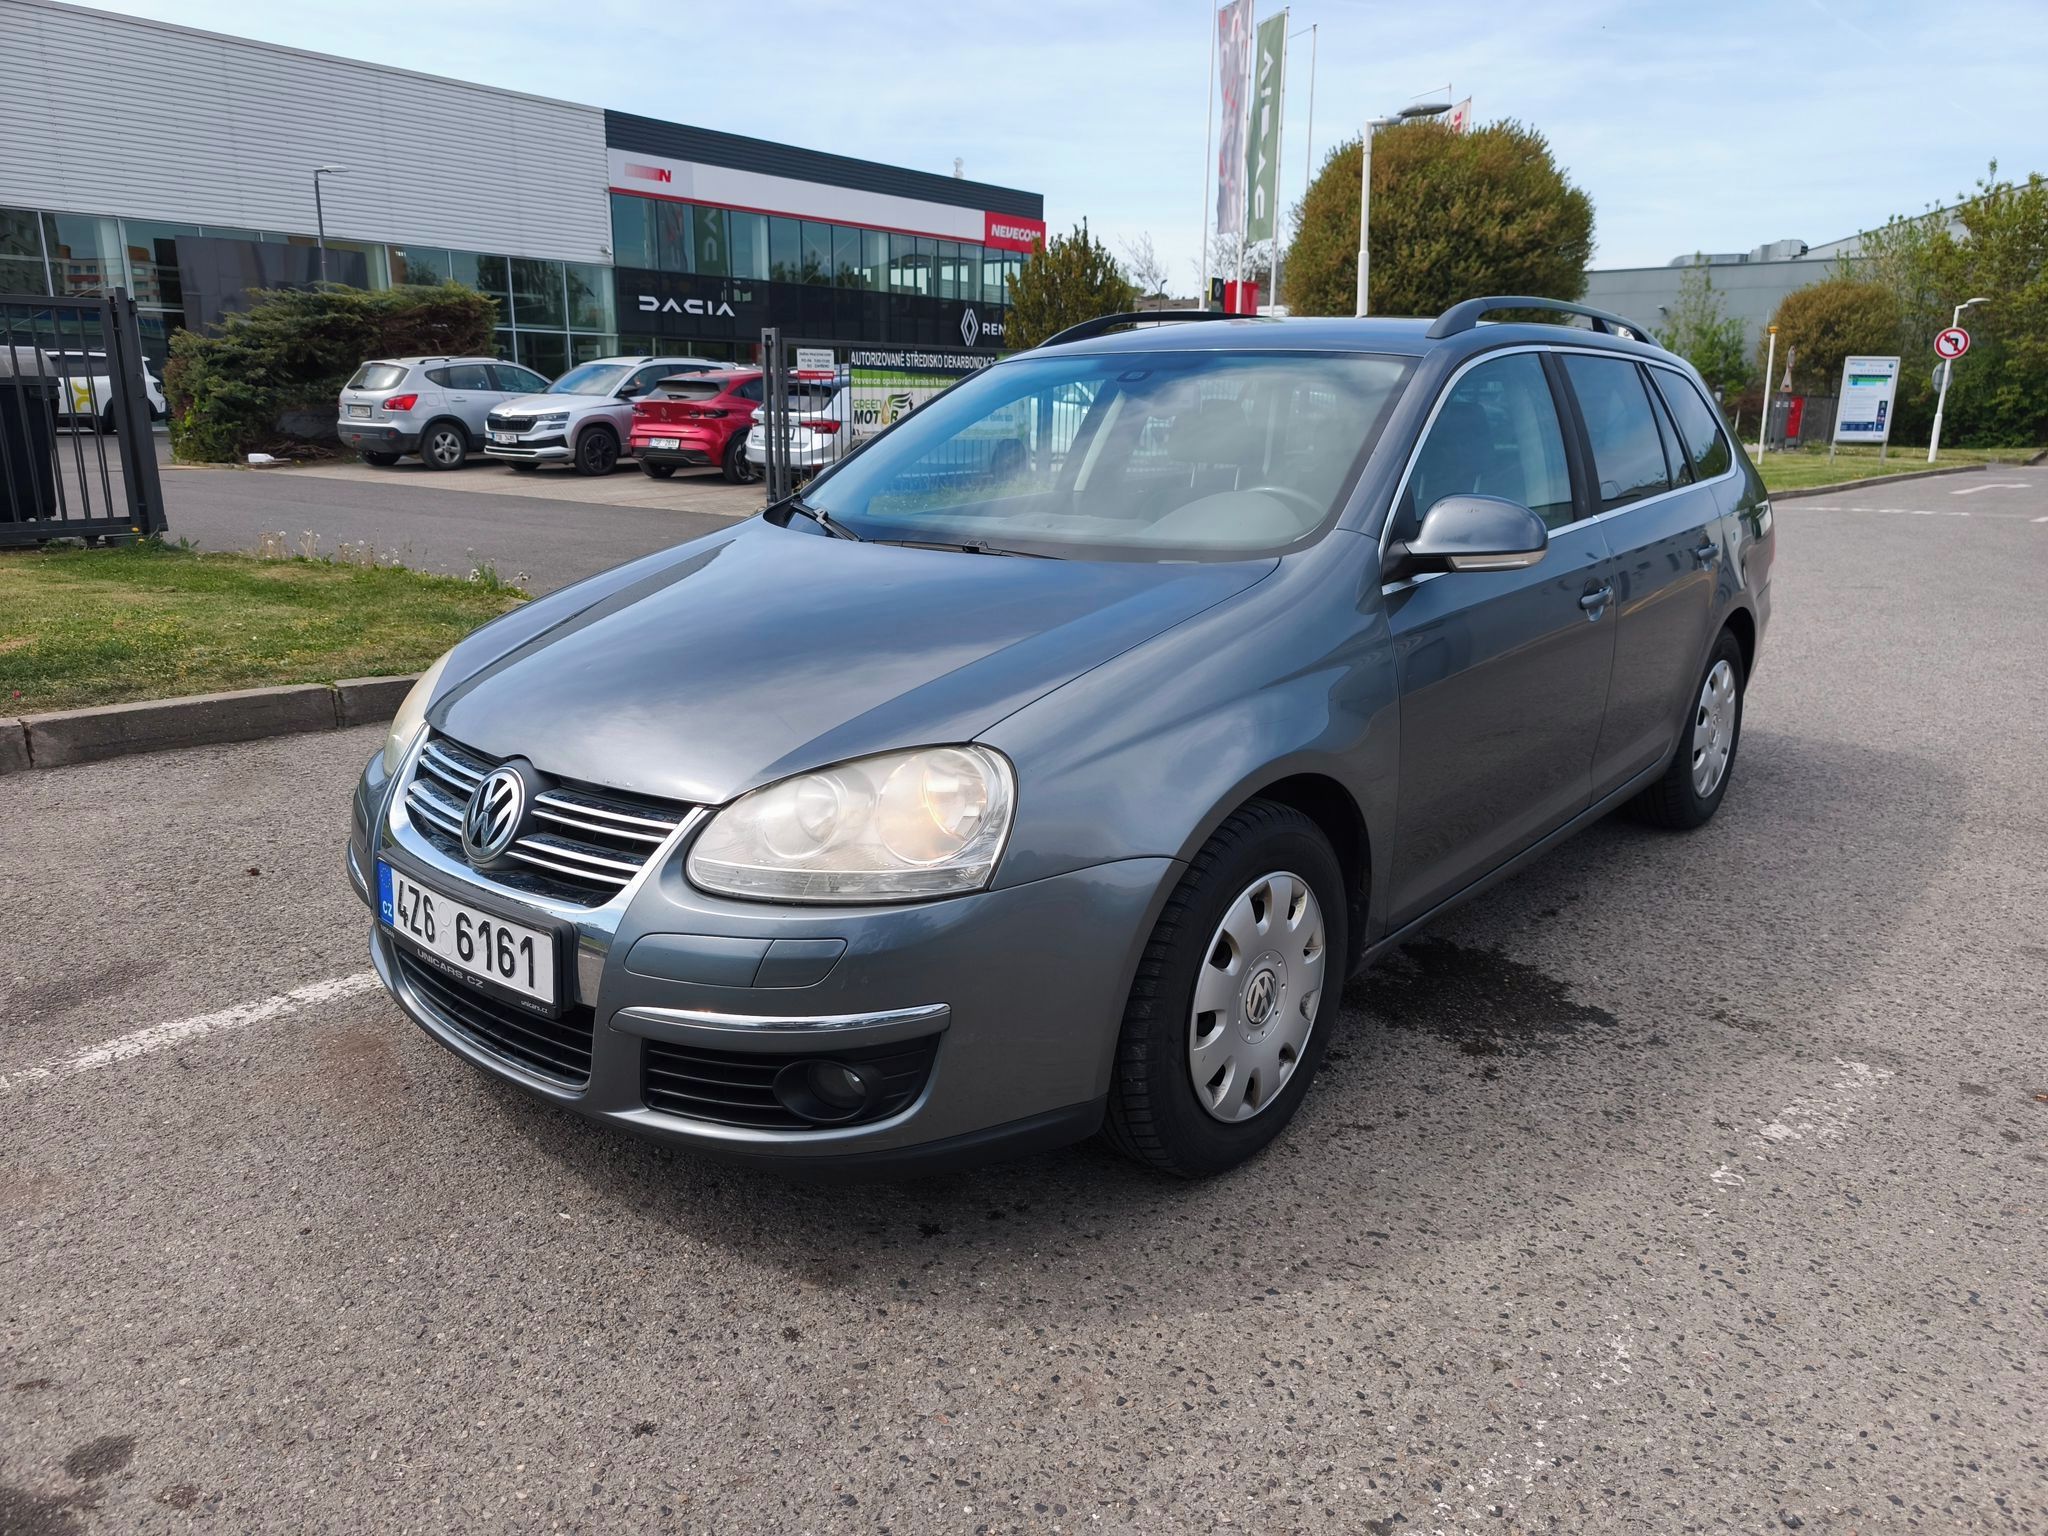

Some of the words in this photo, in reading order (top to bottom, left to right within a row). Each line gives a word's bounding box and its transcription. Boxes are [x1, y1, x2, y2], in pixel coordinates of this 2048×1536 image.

[638, 295, 736, 317] DACIA
[982, 322, 1007, 336] REN
[851, 350, 905, 367] AUTORIZOVANÉ
[905, 351, 942, 368] STŘEDISKO
[382, 900, 393, 918] CZ
[397, 879, 436, 944] 4Z6
[455, 911, 536, 990] 6161
[416, 948, 464, 979] UNICARS
[466, 975, 485, 989] CZ
